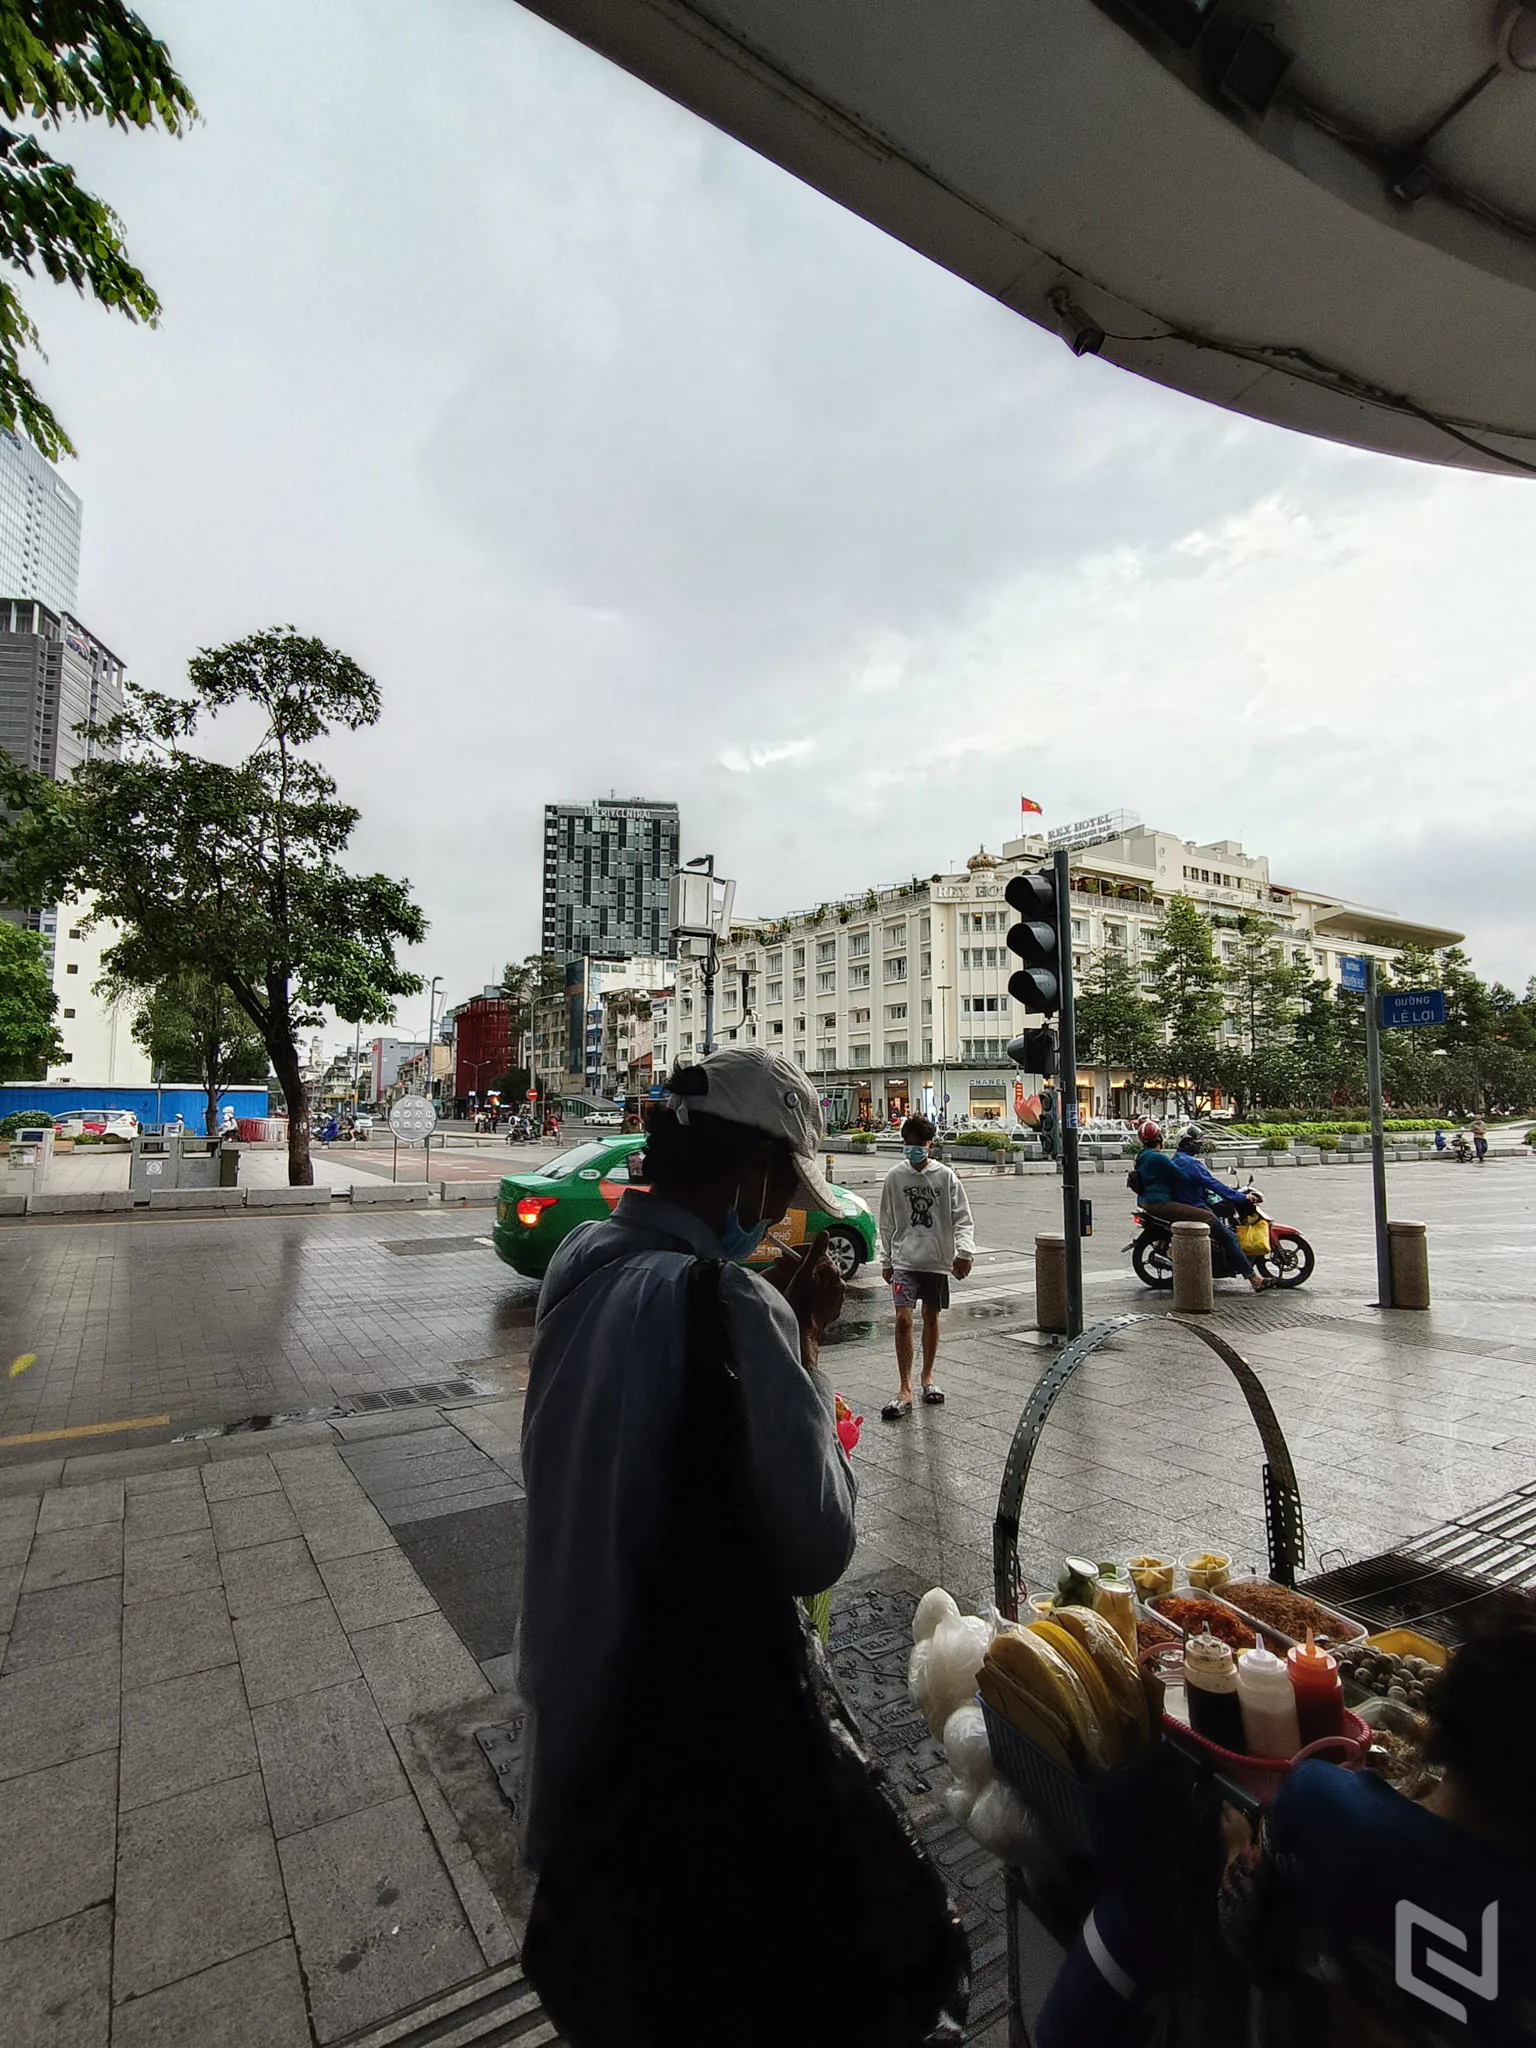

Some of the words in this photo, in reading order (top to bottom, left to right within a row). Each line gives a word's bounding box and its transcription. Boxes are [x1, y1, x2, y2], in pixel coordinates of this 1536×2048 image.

[1048, 826, 1072, 839] REX
[1074, 814, 1113, 832] HOTEL
[937, 886, 970, 899] REX
[975, 885, 1006, 898] HOT
[1394, 996, 1430, 1007] ĐƯỜNG
[1392, 1009, 1409, 1024] LÊ
[1412, 1009, 1435, 1024] LỢI
